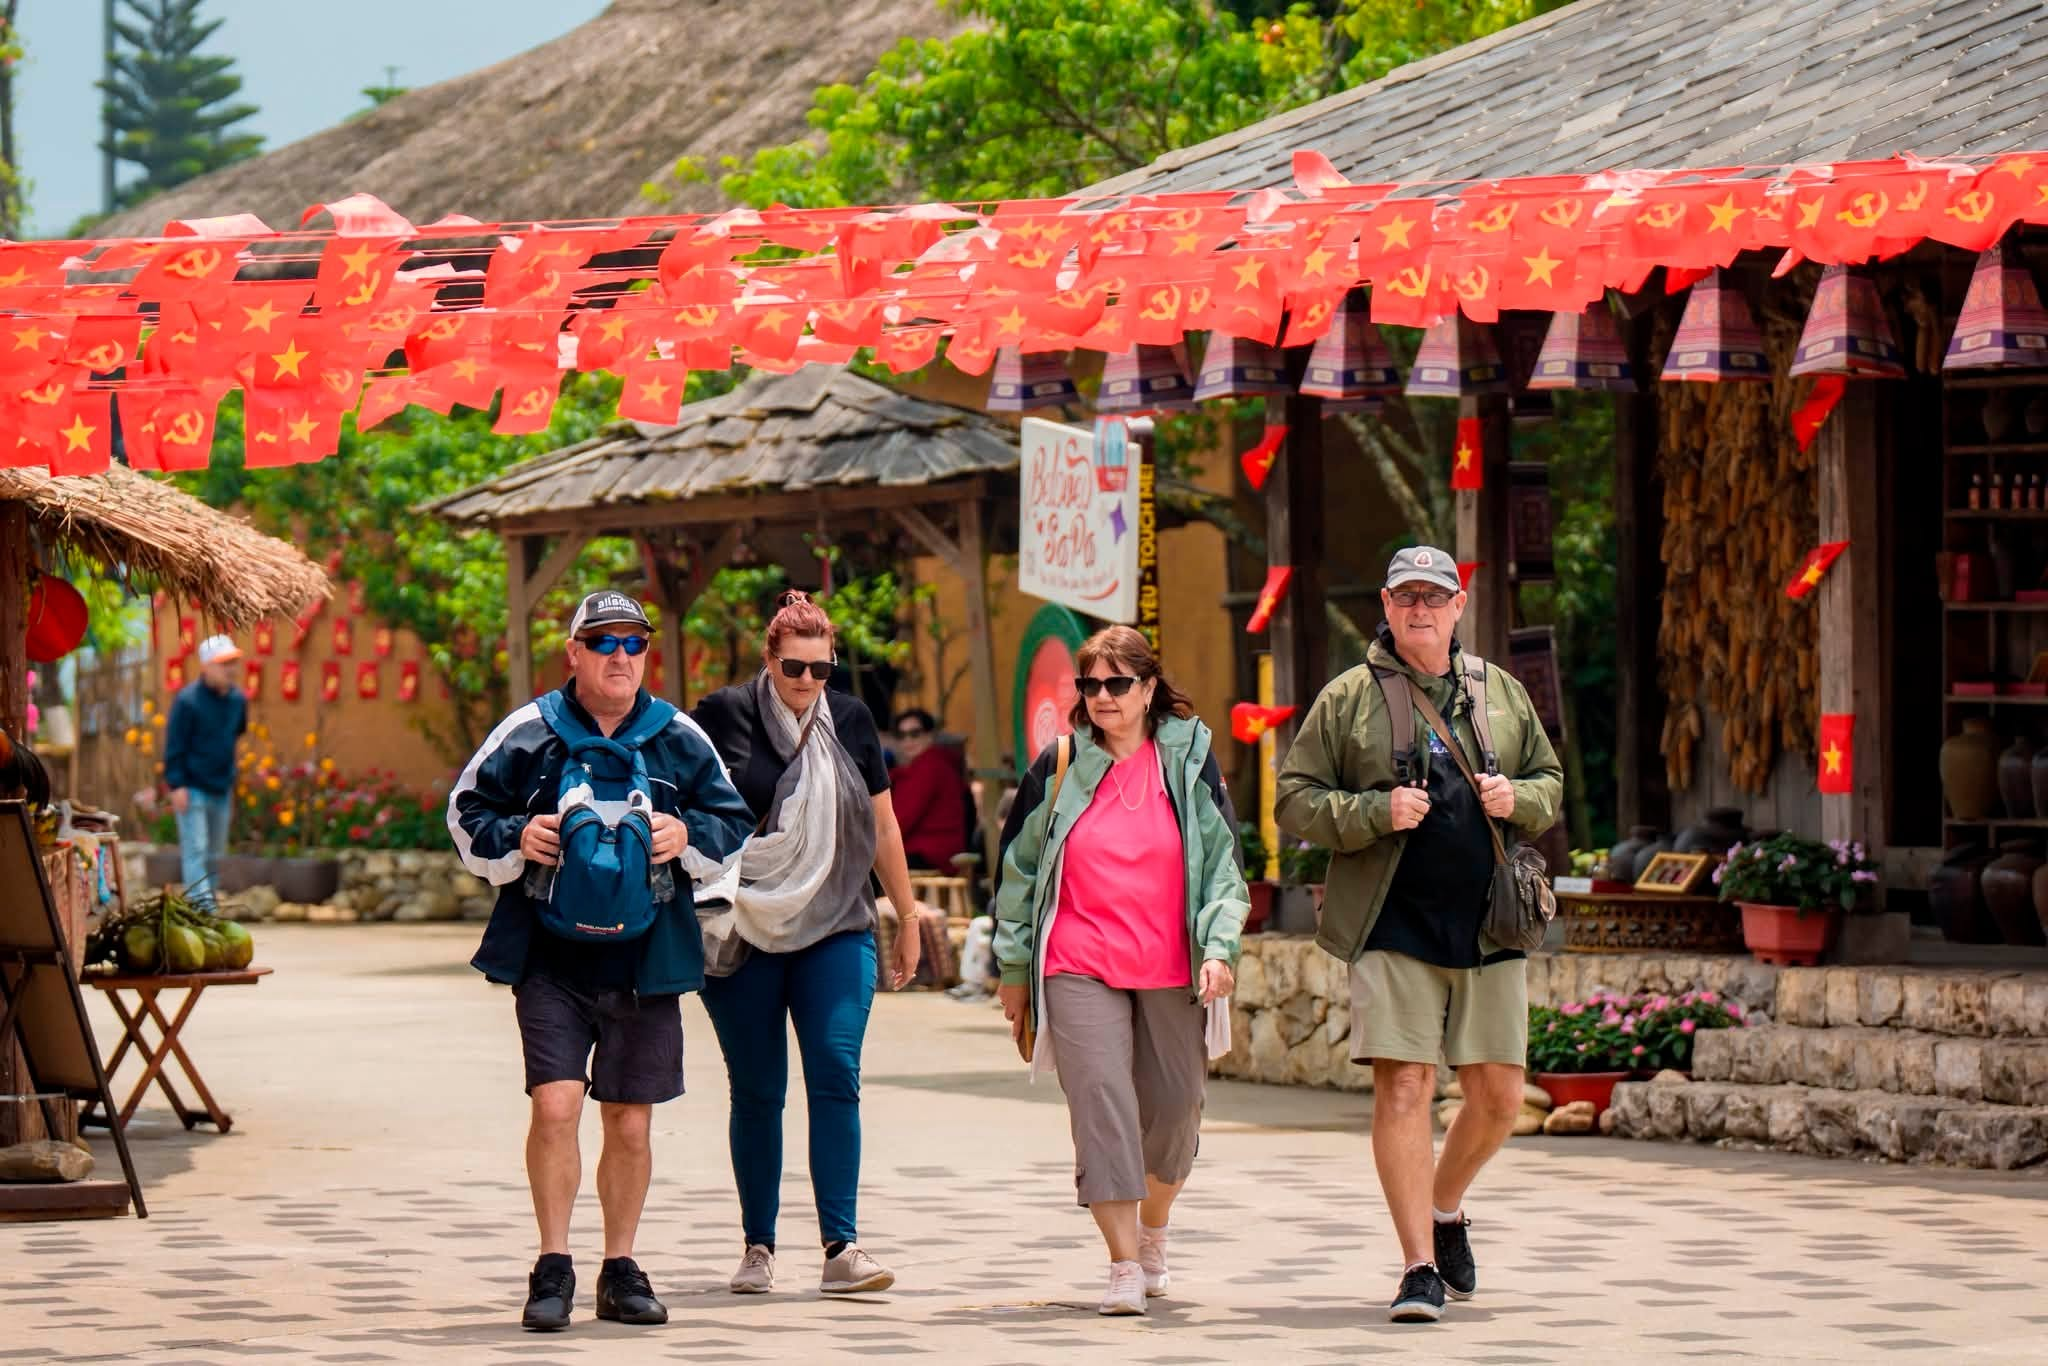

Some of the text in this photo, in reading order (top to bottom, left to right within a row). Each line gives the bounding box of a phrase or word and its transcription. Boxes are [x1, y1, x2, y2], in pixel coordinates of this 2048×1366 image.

[1138, 463, 1156, 498] ME!
[1138, 503, 1158, 568] TOUCH
[1137, 584, 1158, 621] YÊU
